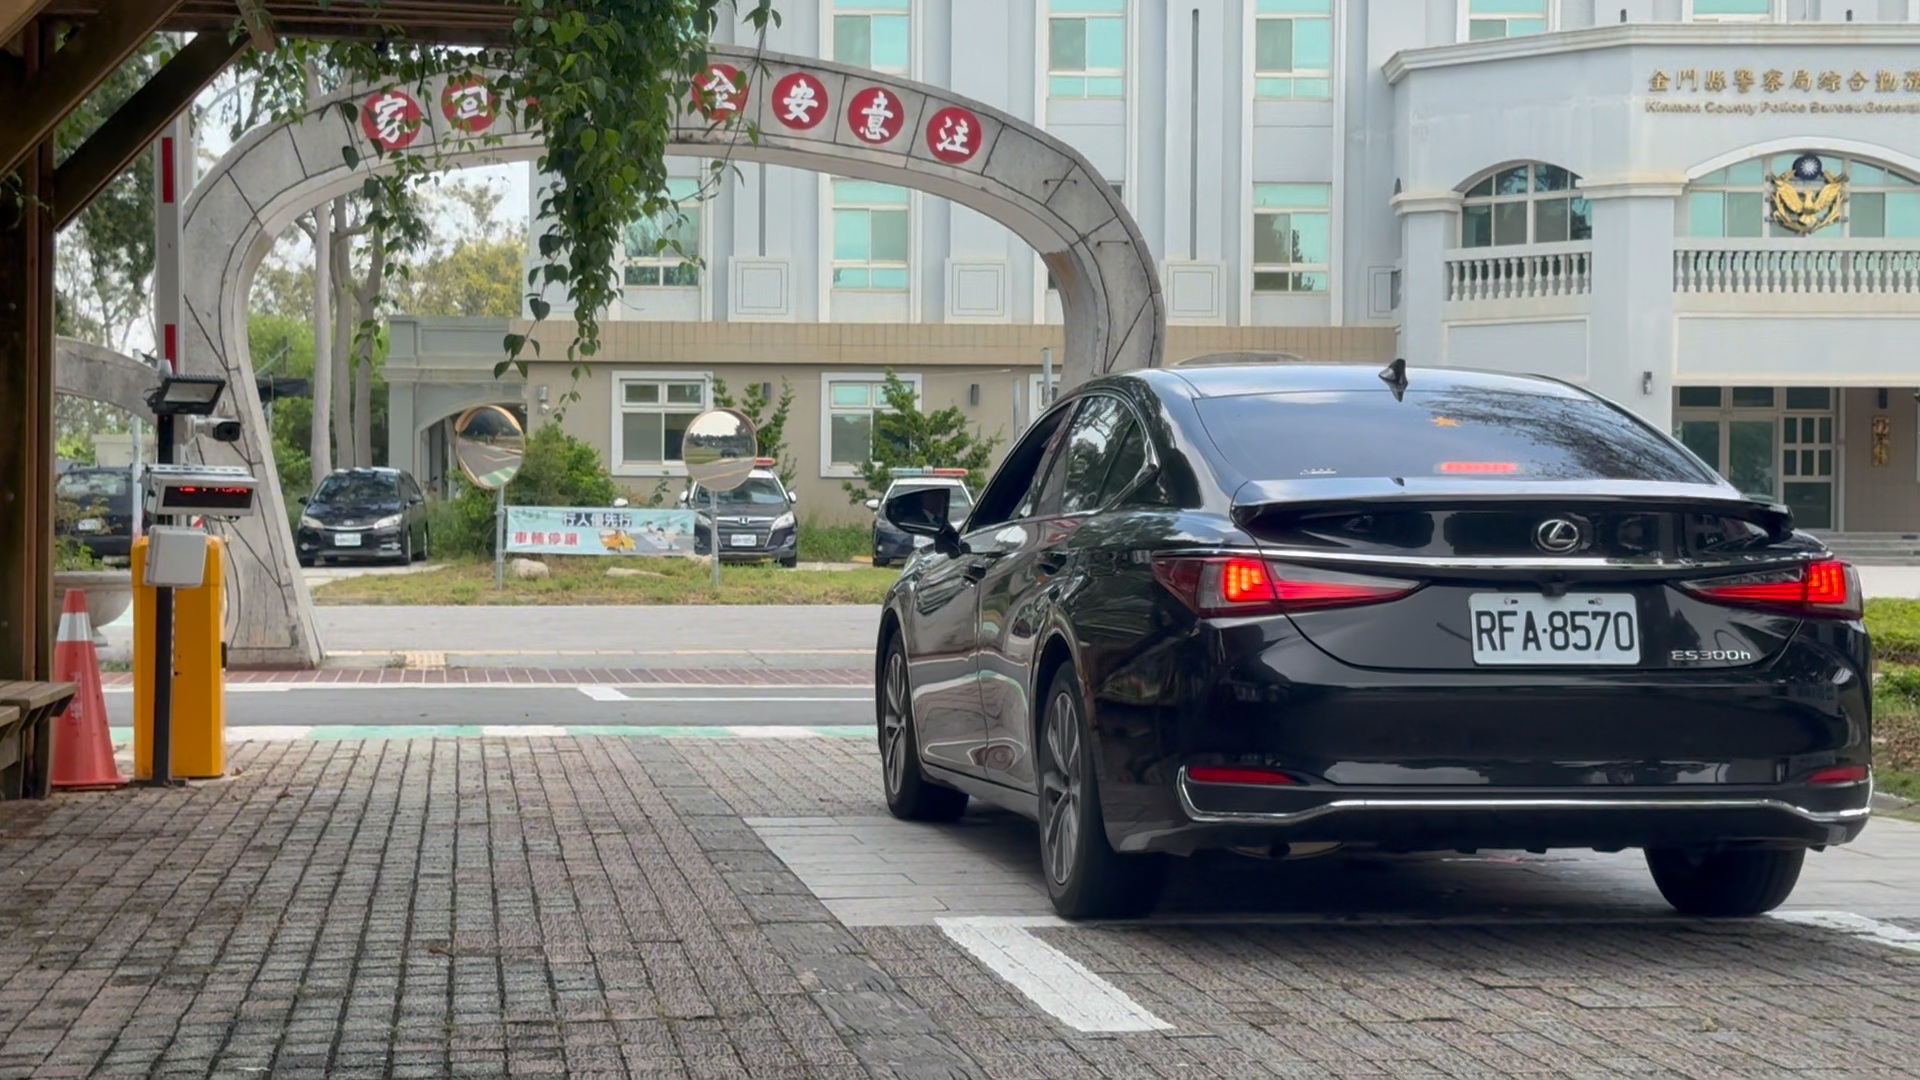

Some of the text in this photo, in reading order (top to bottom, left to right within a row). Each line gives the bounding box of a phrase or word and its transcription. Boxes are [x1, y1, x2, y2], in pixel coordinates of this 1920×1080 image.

[1645, 102, 1701, 113] Kinmen
[1704, 102, 1757, 115] County
[1761, 102, 1806, 113] Police
[1810, 102, 1862, 113] Bureau
[1671, 650, 1751, 661] ES300h
